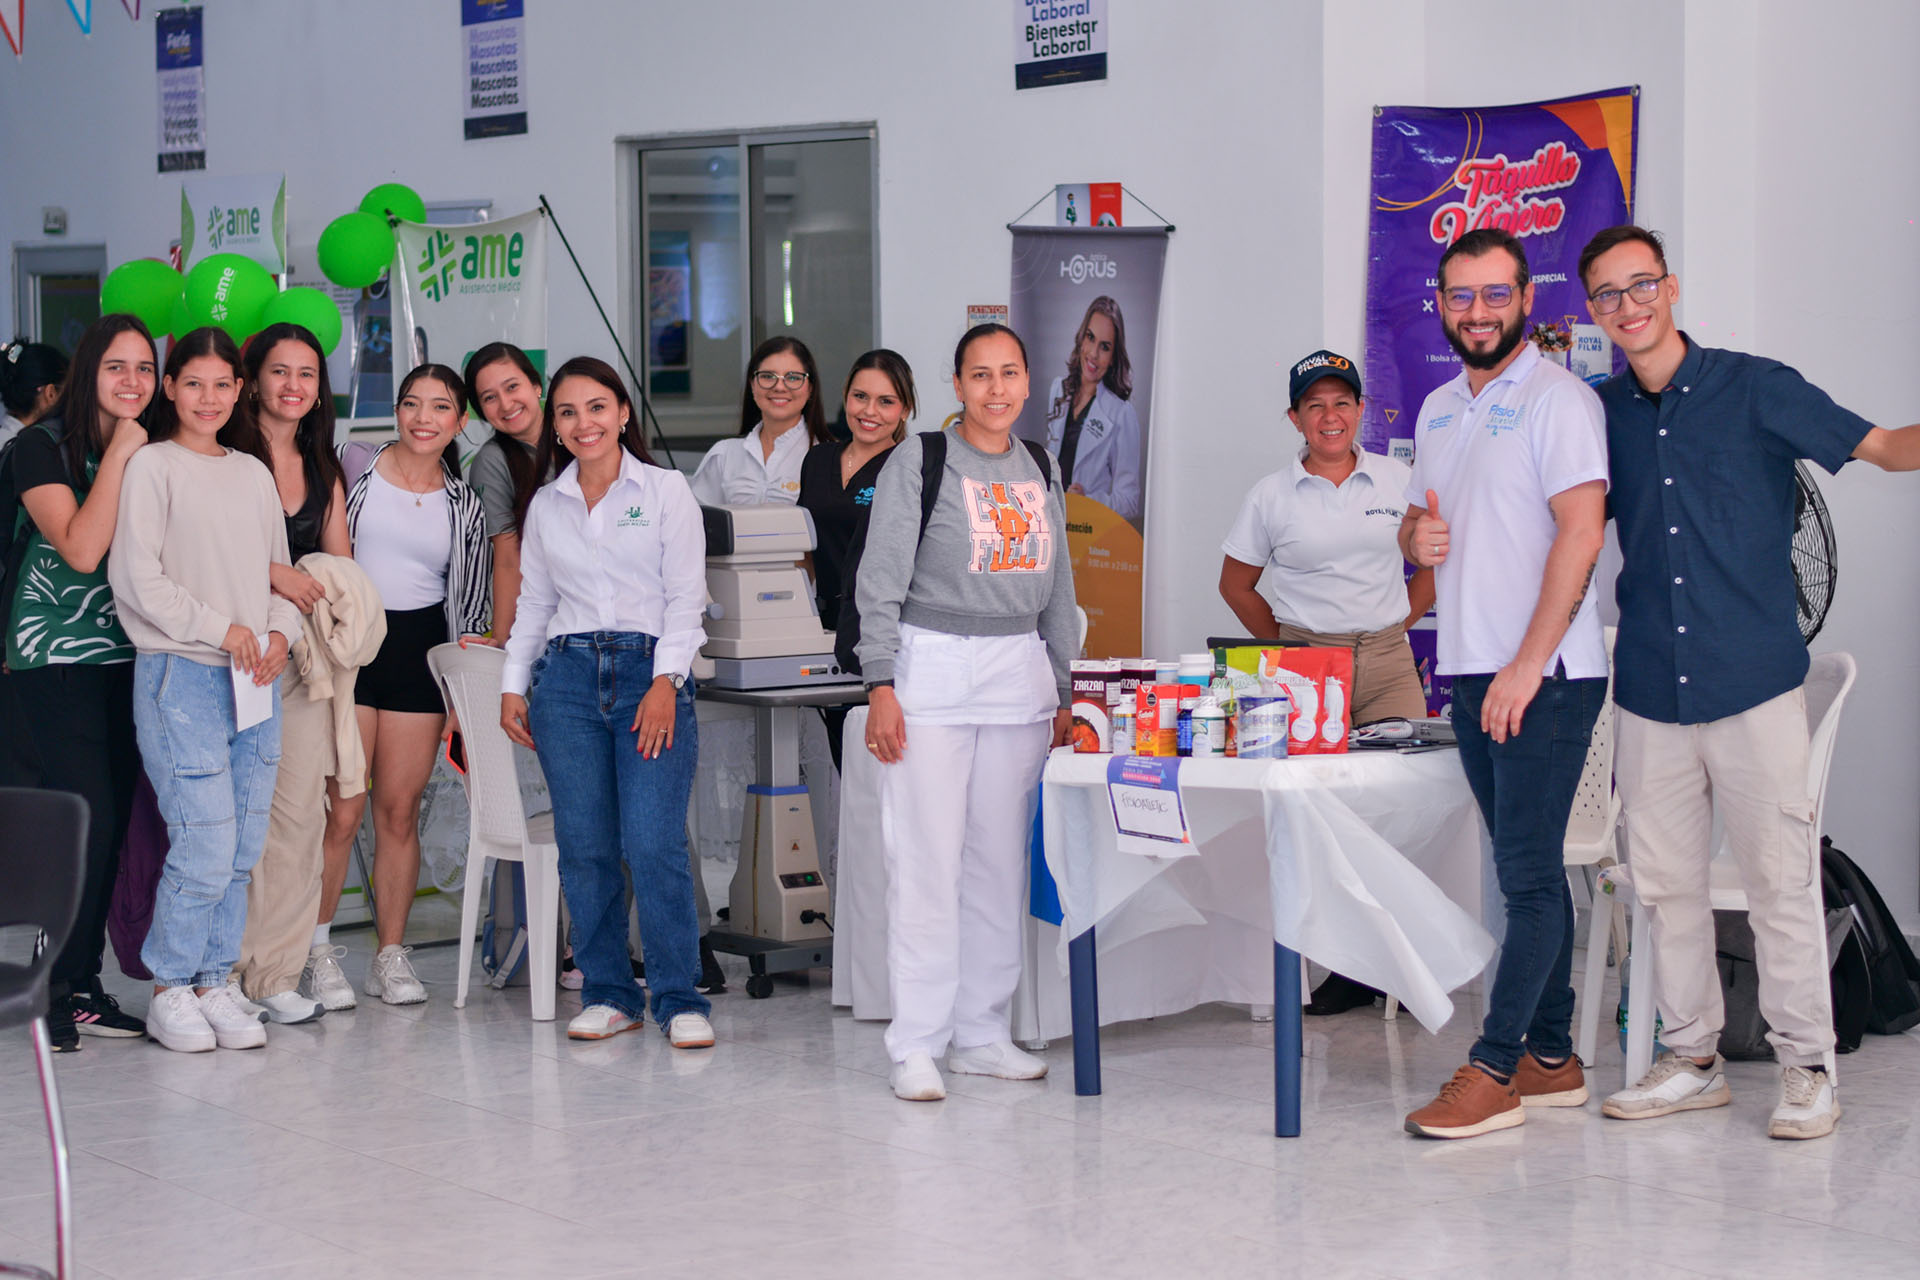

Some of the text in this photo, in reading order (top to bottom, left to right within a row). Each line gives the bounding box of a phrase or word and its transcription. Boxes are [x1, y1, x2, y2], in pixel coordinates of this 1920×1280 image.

[1032, 0, 1090, 22] Laboral
[1025, 20, 1098, 42] Bienestar
[469, 42, 518, 59] Mascotas
[1033, 33, 1091, 58] Laboral
[470, 59, 518, 76] Mascotas
[470, 75, 519, 92] Mascotas
[471, 91, 519, 109] Mascotas
[1456, 144, 1580, 208] Taquilla
[226, 207, 261, 236] ame
[461, 231, 524, 280] ame
[1060, 254, 1117, 284] HORUS
[214, 266, 235, 302] ame
[1532, 273, 1567, 283] ESPECIAL
[969, 305, 1007, 313] EXTINTOR
[1578, 336, 1603, 344] ROYAL
[1578, 343, 1603, 351] FILMS
[1430, 354, 1450, 362] Bolsa
[1073, 680, 1105, 692] ZARZAN
[1121, 679, 1140, 690] RZAN
[1440, 687, 1453, 697] Tarj
